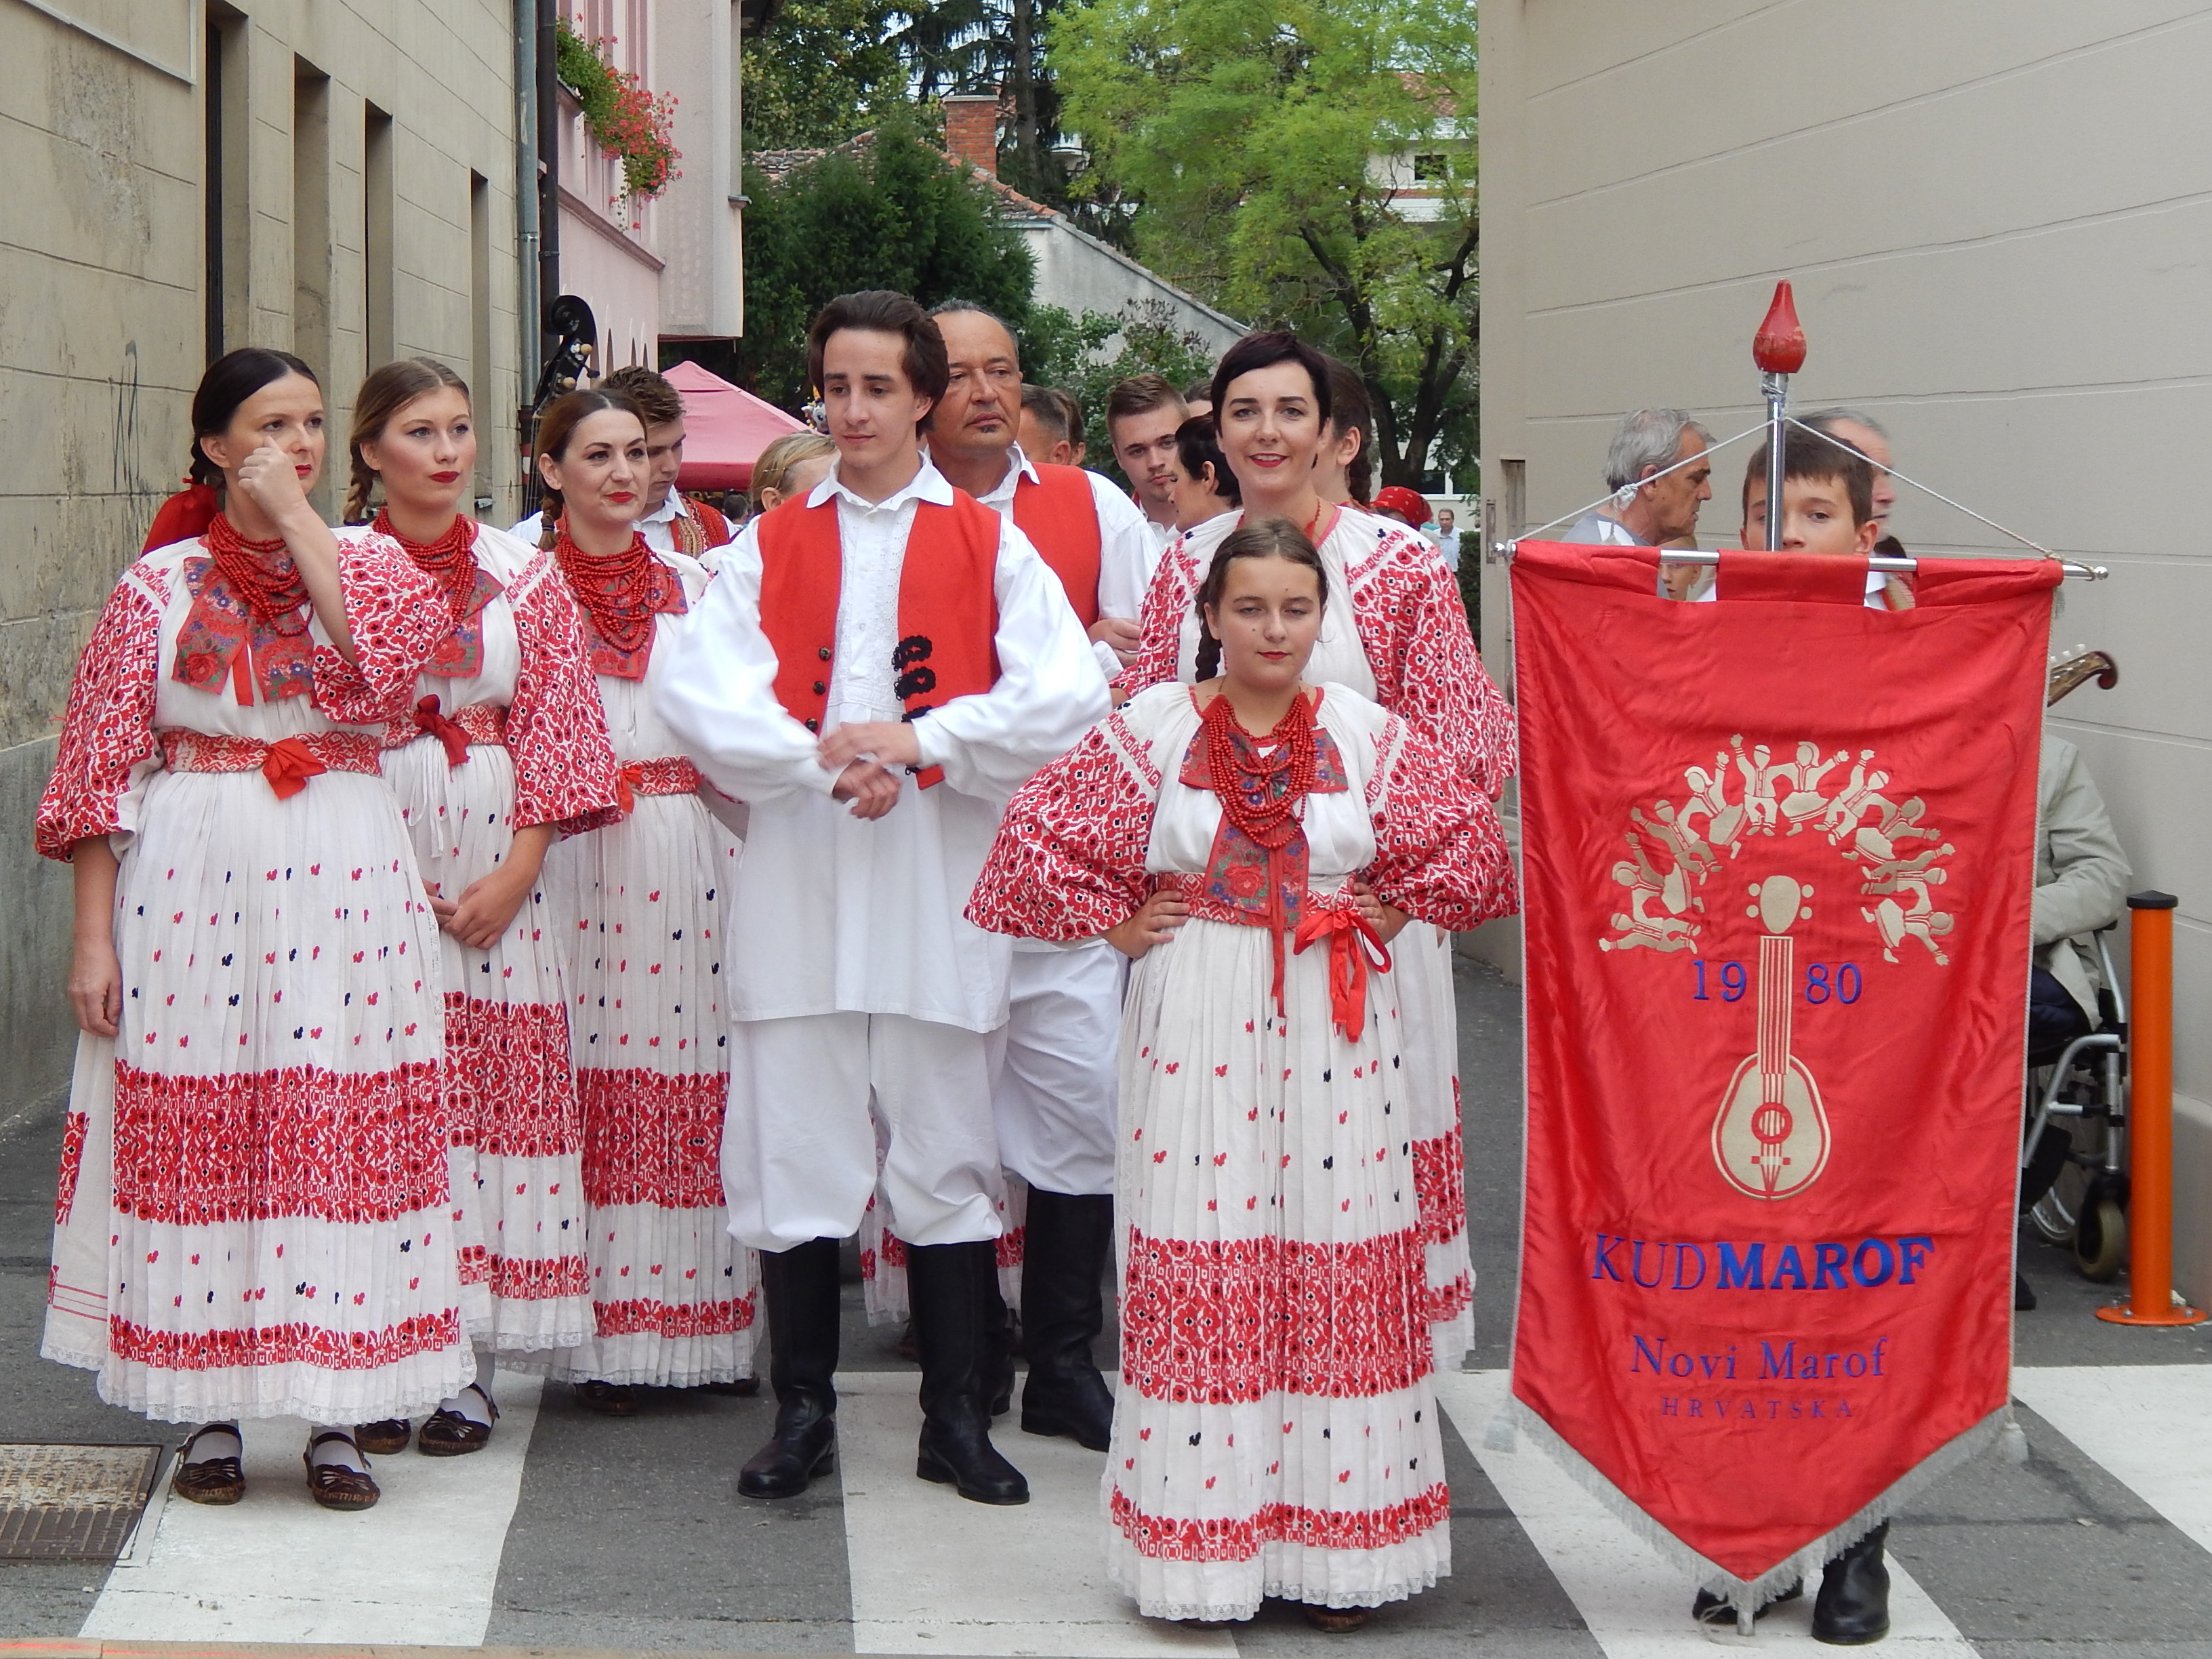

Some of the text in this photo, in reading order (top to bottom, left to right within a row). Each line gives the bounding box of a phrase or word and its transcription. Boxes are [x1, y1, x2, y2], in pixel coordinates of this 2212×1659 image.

[1630, 1334, 1889, 1380] Novi Marof
[1660, 1396, 1852, 1419] HRVATSKA
